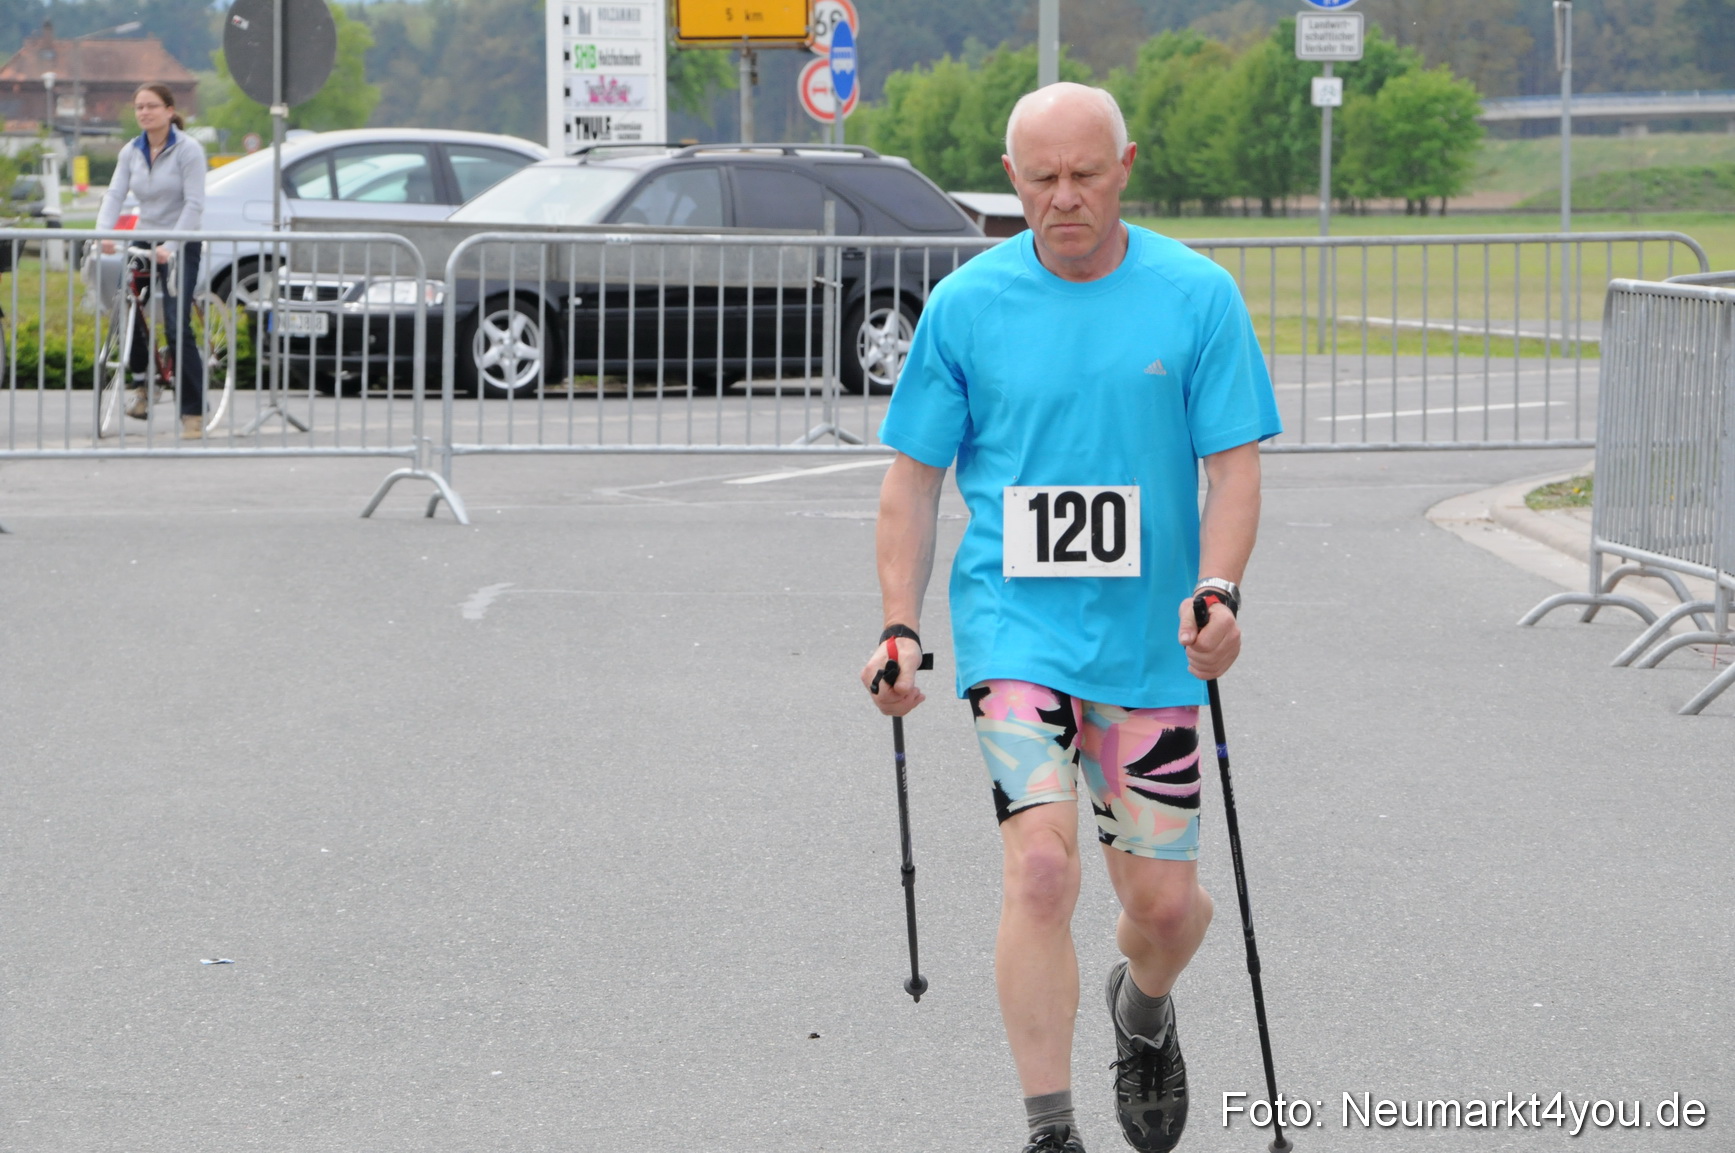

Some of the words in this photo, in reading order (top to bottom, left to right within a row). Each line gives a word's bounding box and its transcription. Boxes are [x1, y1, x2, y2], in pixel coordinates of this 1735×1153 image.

[726, 7, 733, 22] 5
[745, 9, 763, 22] km
[1028, 491, 1126, 563] 120
